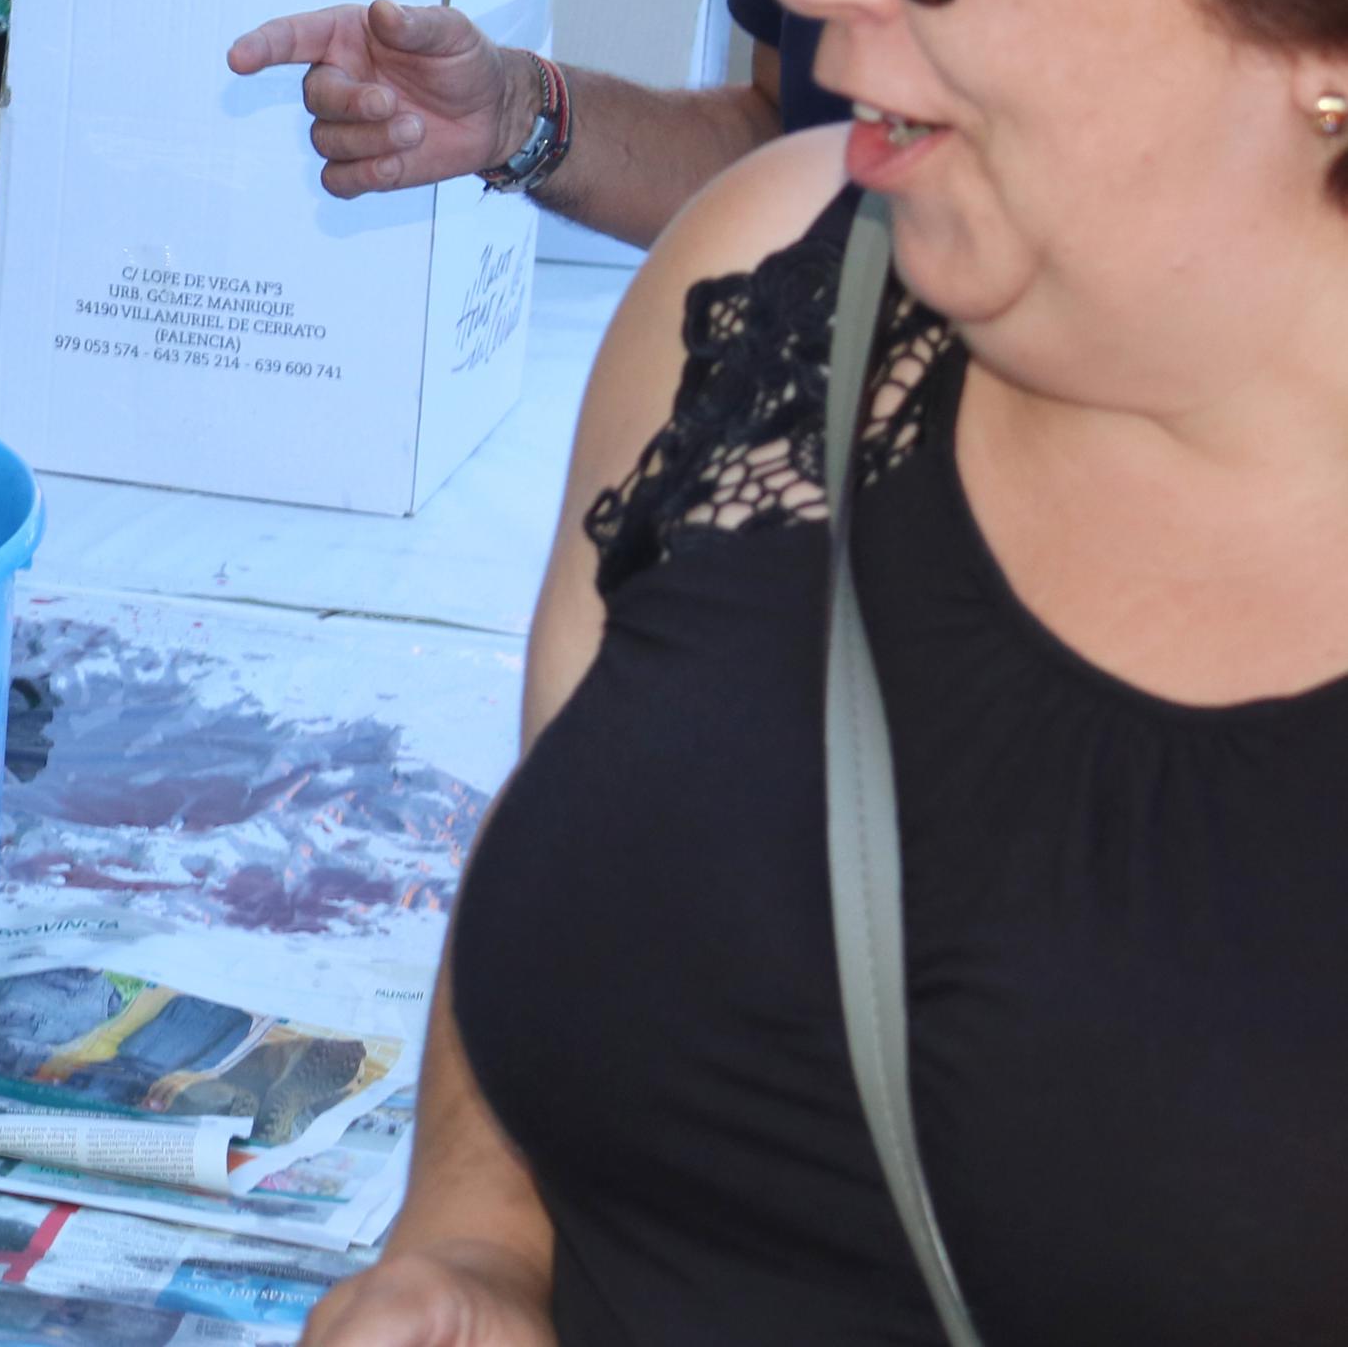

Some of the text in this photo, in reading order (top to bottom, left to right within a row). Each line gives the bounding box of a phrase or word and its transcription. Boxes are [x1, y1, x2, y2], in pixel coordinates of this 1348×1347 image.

[122, 266, 139, 281] C/
[142, 268, 181, 286] LOPE
[184, 273, 205, 289] DE
[209, 276, 250, 293] VEGA
[109, 283, 143, 301] URB.
[207, 295, 295, 317] MANRIQUE
[75, 298, 326, 339] 34190 VILLAMURIEL DE CERRATO
[54, 334, 81, 351] 979
[84, 338, 110, 355] 053
[114, 341, 139, 358] 574
[153, 347, 179, 362] 643
[184, 350, 209, 366] 785
[214, 354, 240, 369] 214
[255, 358, 281, 373] 639
[285, 361, 312, 377] 600
[316, 364, 343, 379] 741
[155, 327, 241, 353] (PALENCIA)
